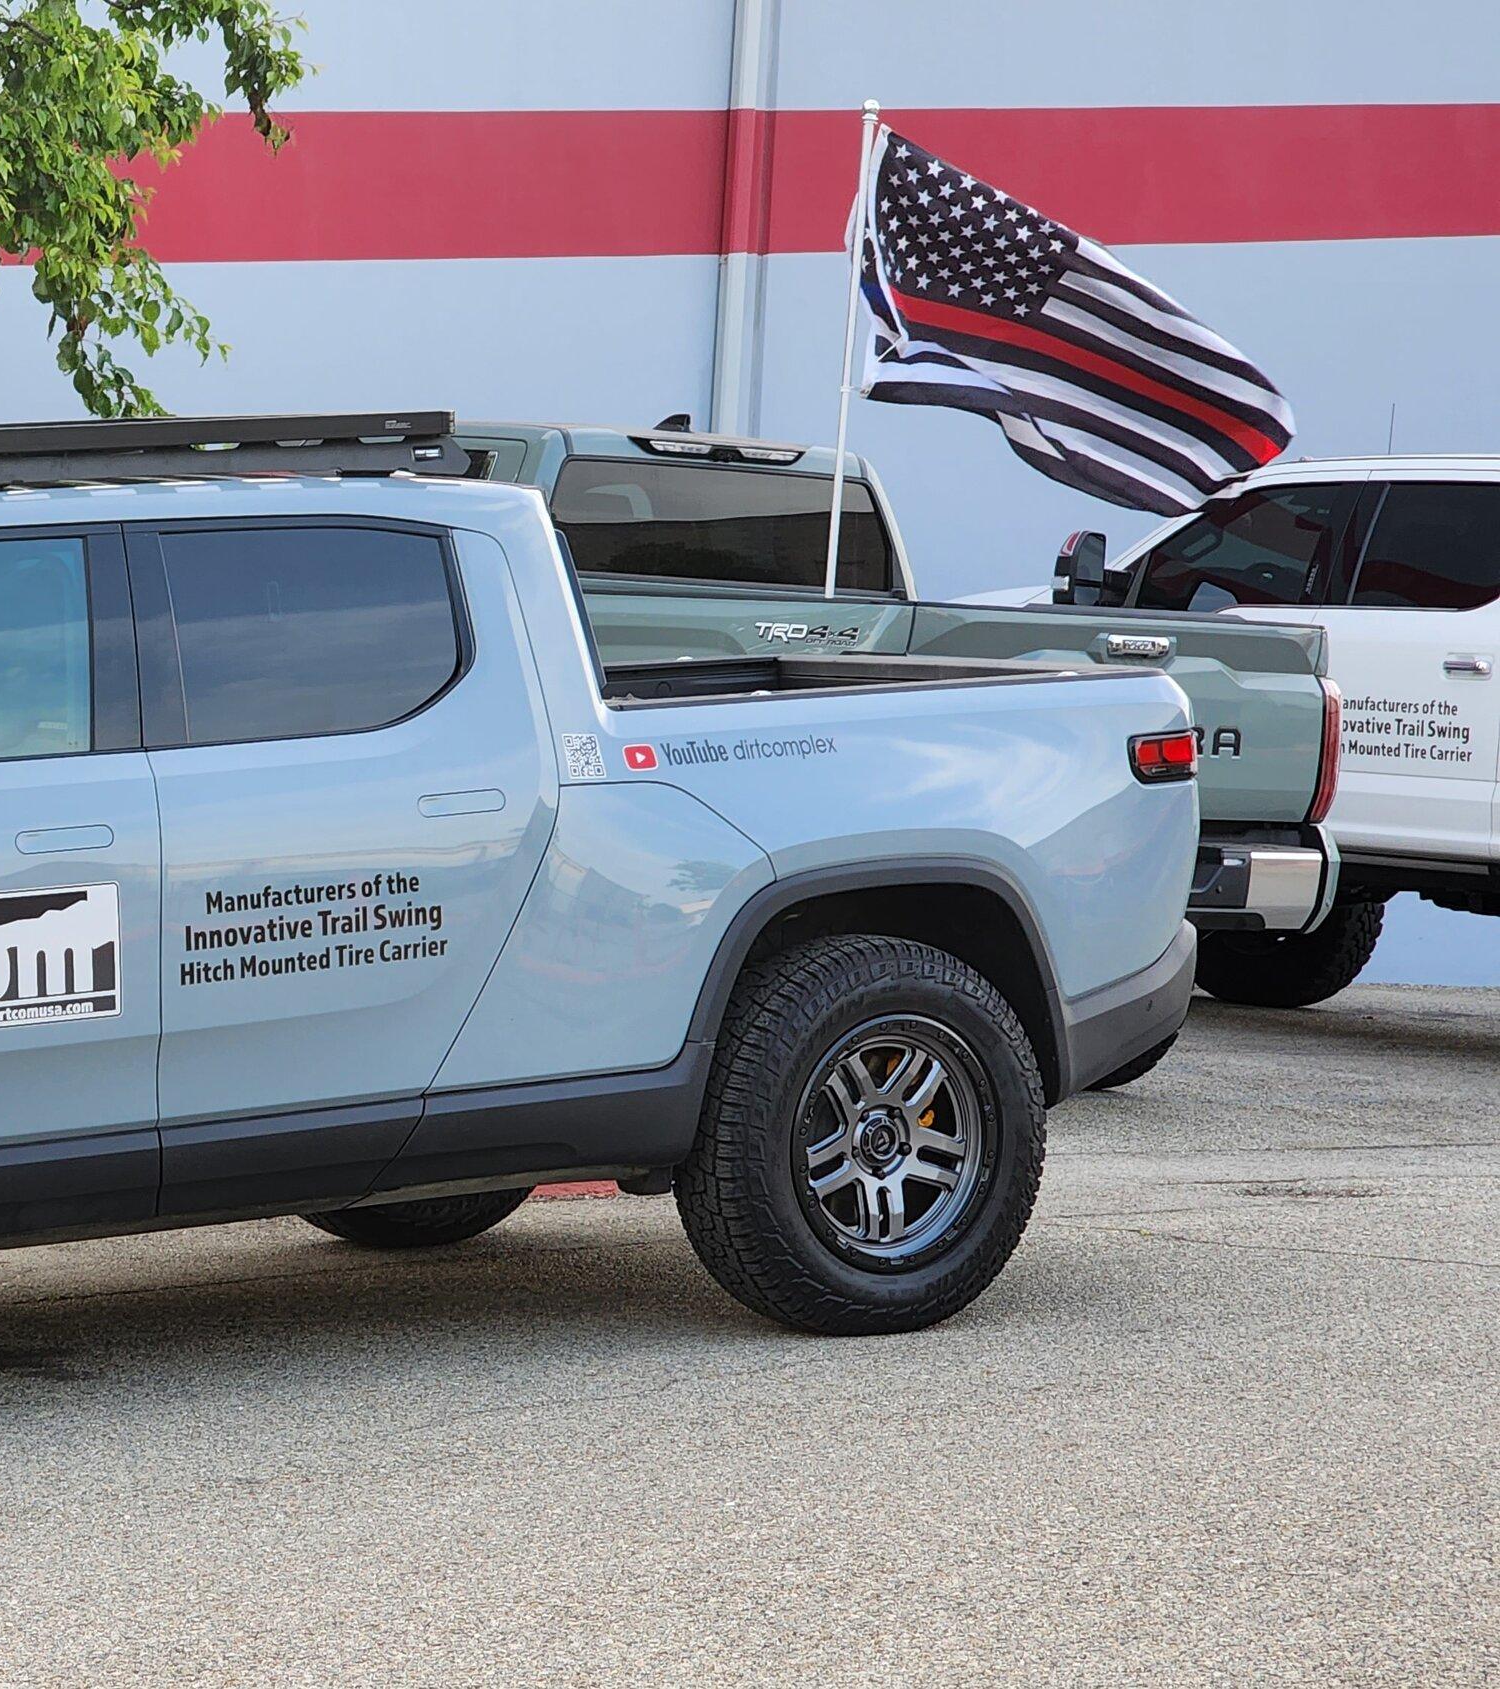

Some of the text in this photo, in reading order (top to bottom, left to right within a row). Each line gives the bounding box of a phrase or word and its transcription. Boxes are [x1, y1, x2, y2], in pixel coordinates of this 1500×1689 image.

[755, 621, 808, 643] TRD
[1342, 696, 1458, 716] anufacturers of the
[1342, 717, 1470, 745] ovative Trail Swing
[660, 734, 838, 767] YouTube dirtcomplex
[1348, 740, 1400, 758] Mounted
[1403, 744, 1427, 760] Tire
[1429, 745, 1473, 762] Carrier
[205, 872, 420, 915] Manufacturers of the
[184, 901, 442, 952] Innovative Trail Swing
[180, 936, 448, 986] Hitch Mounted Tire Carrier
